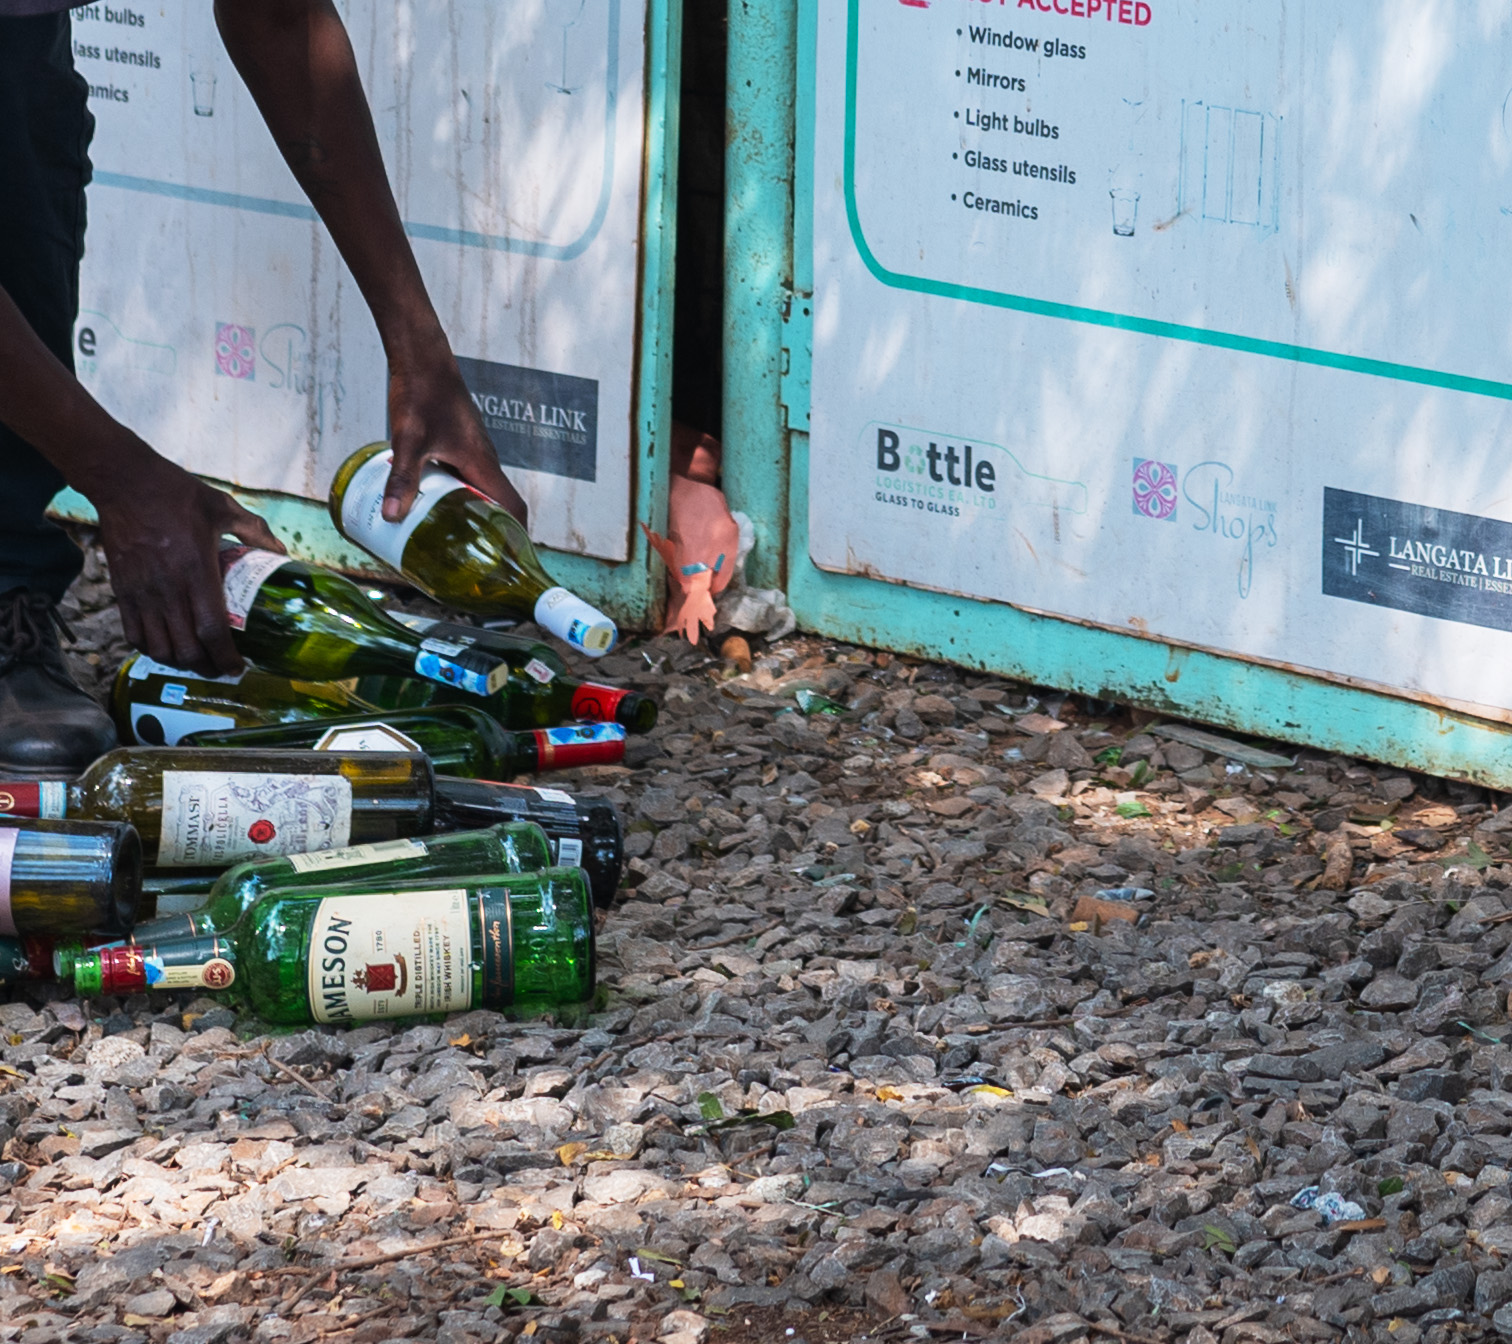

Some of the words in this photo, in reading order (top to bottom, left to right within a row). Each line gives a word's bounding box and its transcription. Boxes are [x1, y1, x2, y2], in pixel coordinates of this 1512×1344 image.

[969, 25, 1038, 52] Window
[1043, 38, 1085, 59] glass
[967, 67, 1025, 92] Mirrors
[963, 191, 1038, 220] Ceramics
[1385, 536, 1488, 576] LANGATA
